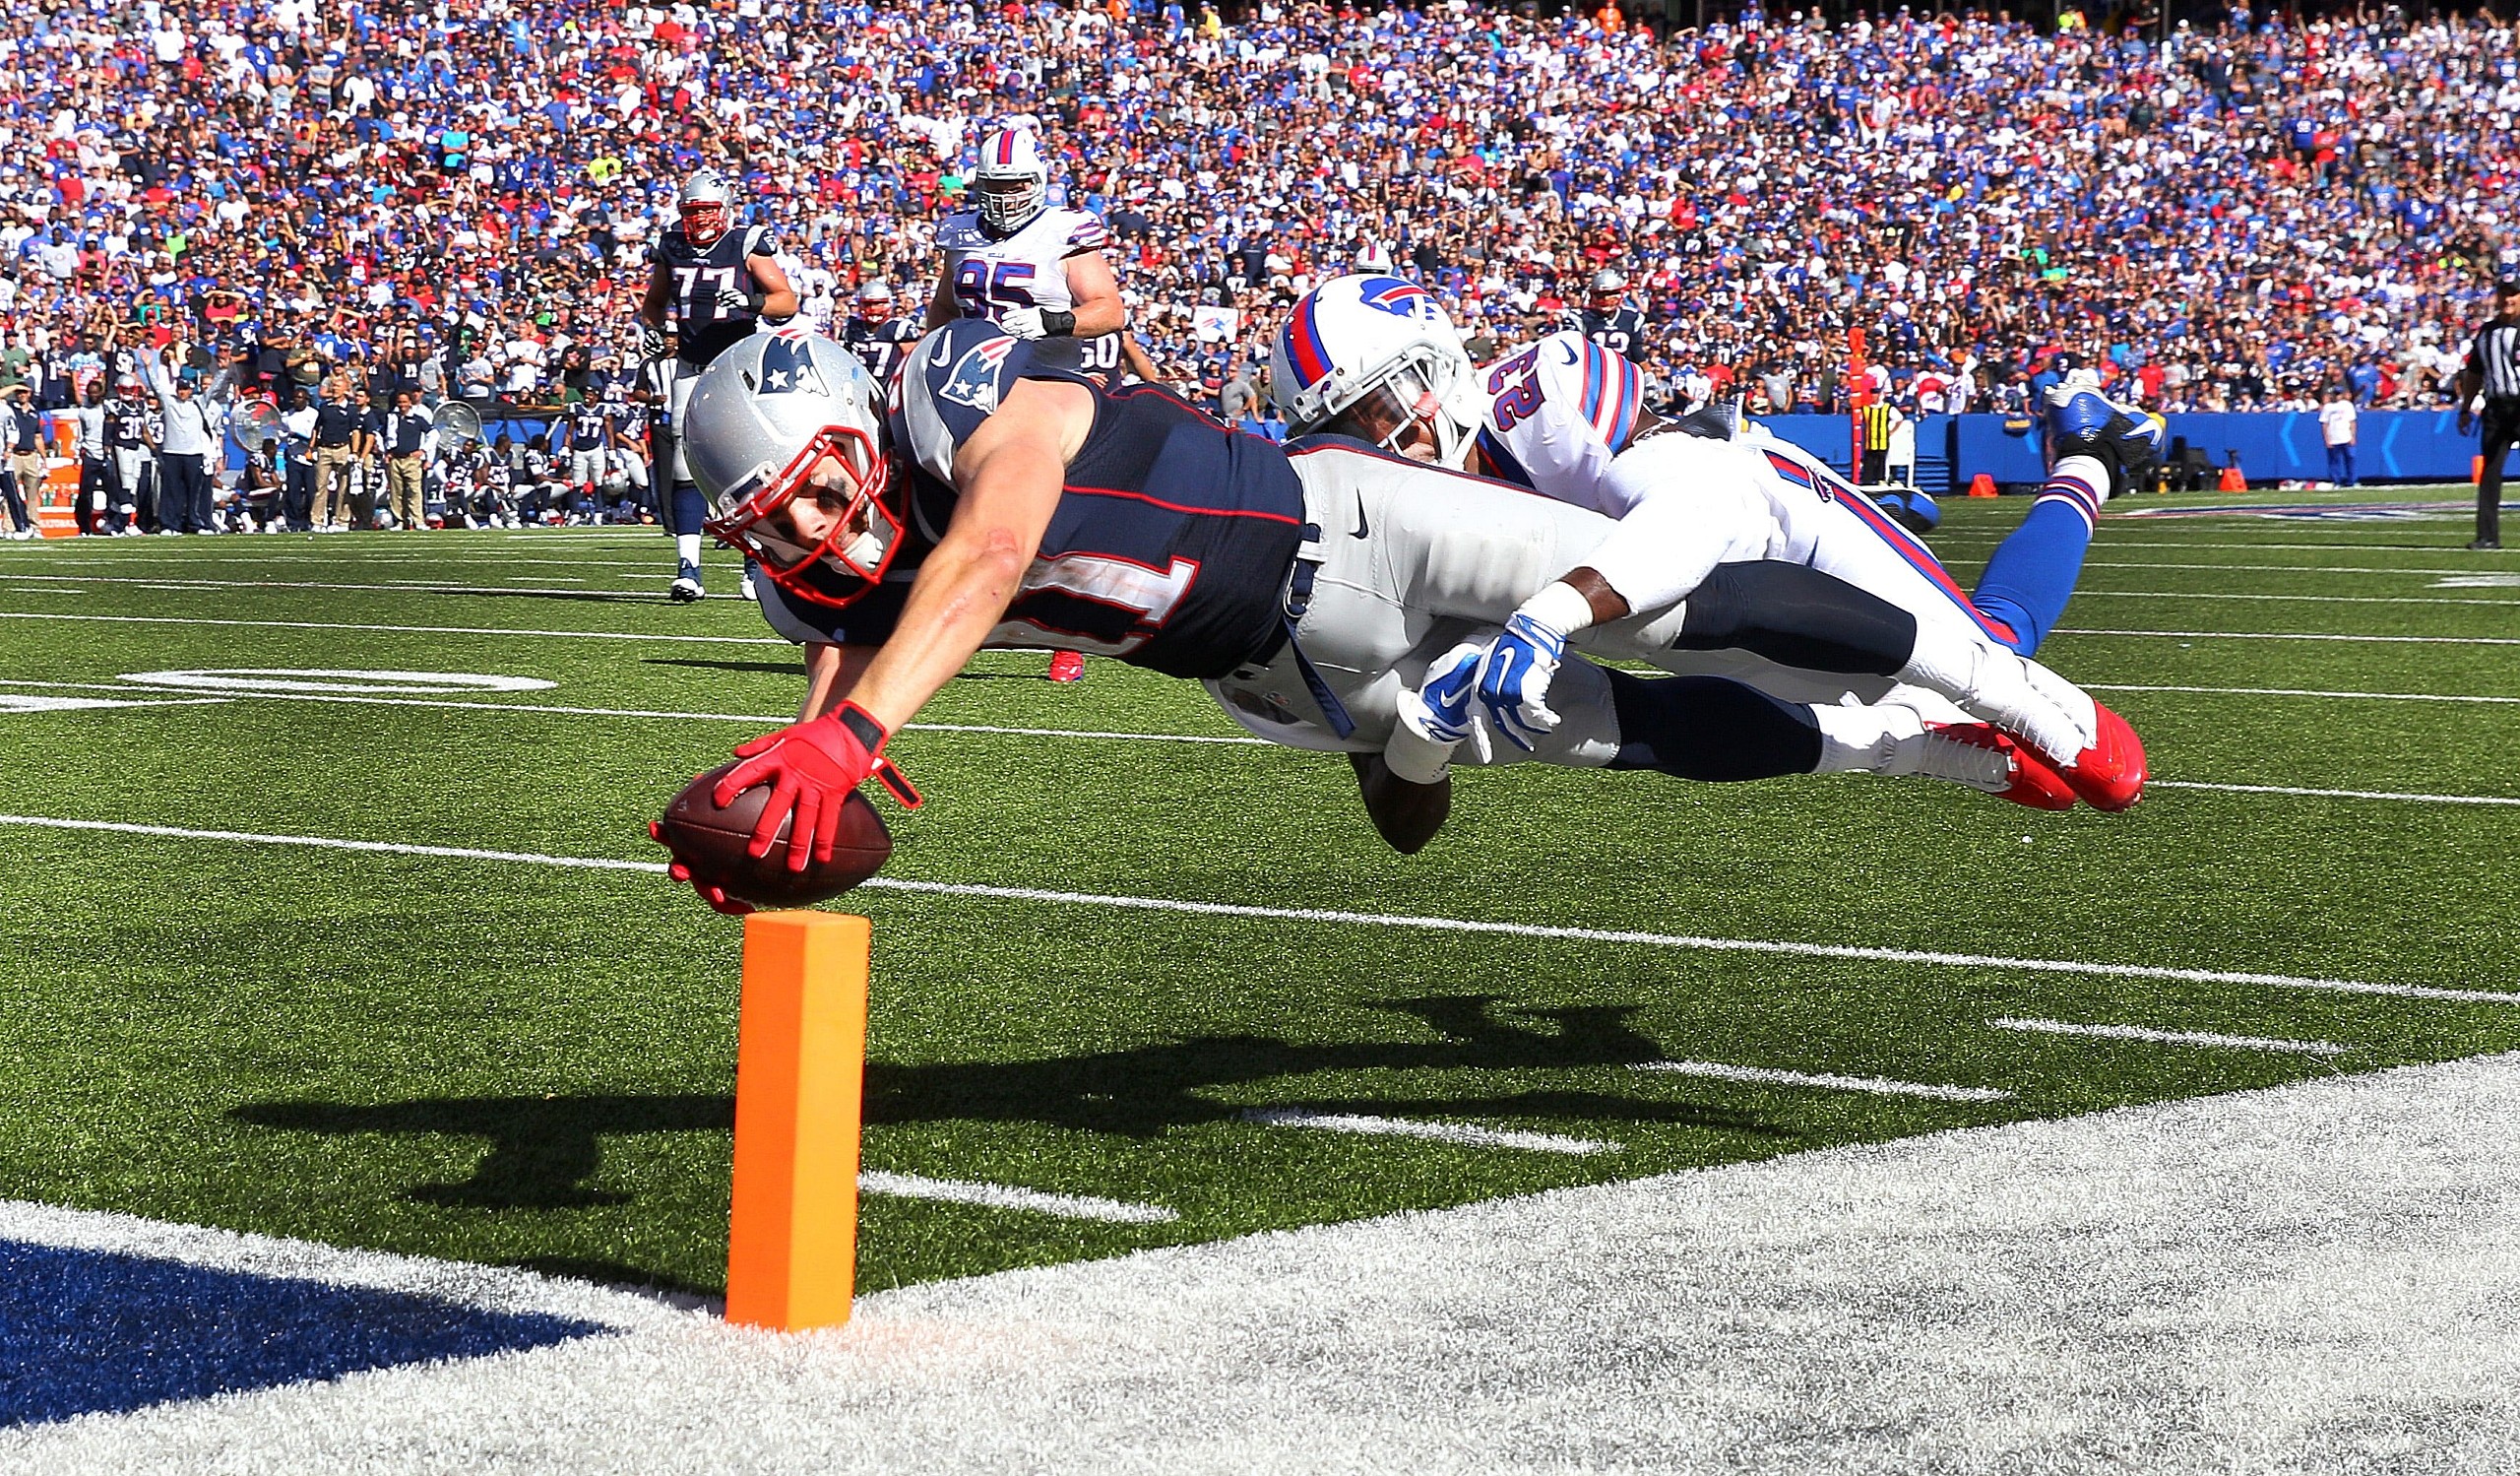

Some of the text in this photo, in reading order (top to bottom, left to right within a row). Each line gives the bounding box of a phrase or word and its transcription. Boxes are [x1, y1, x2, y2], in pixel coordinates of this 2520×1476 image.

[671, 266, 737, 321] 77
[954, 259, 1037, 325] 95
[1592, 332, 1630, 353] 12
[1487, 343, 1546, 432] 23
[577, 416, 603, 439] 37
